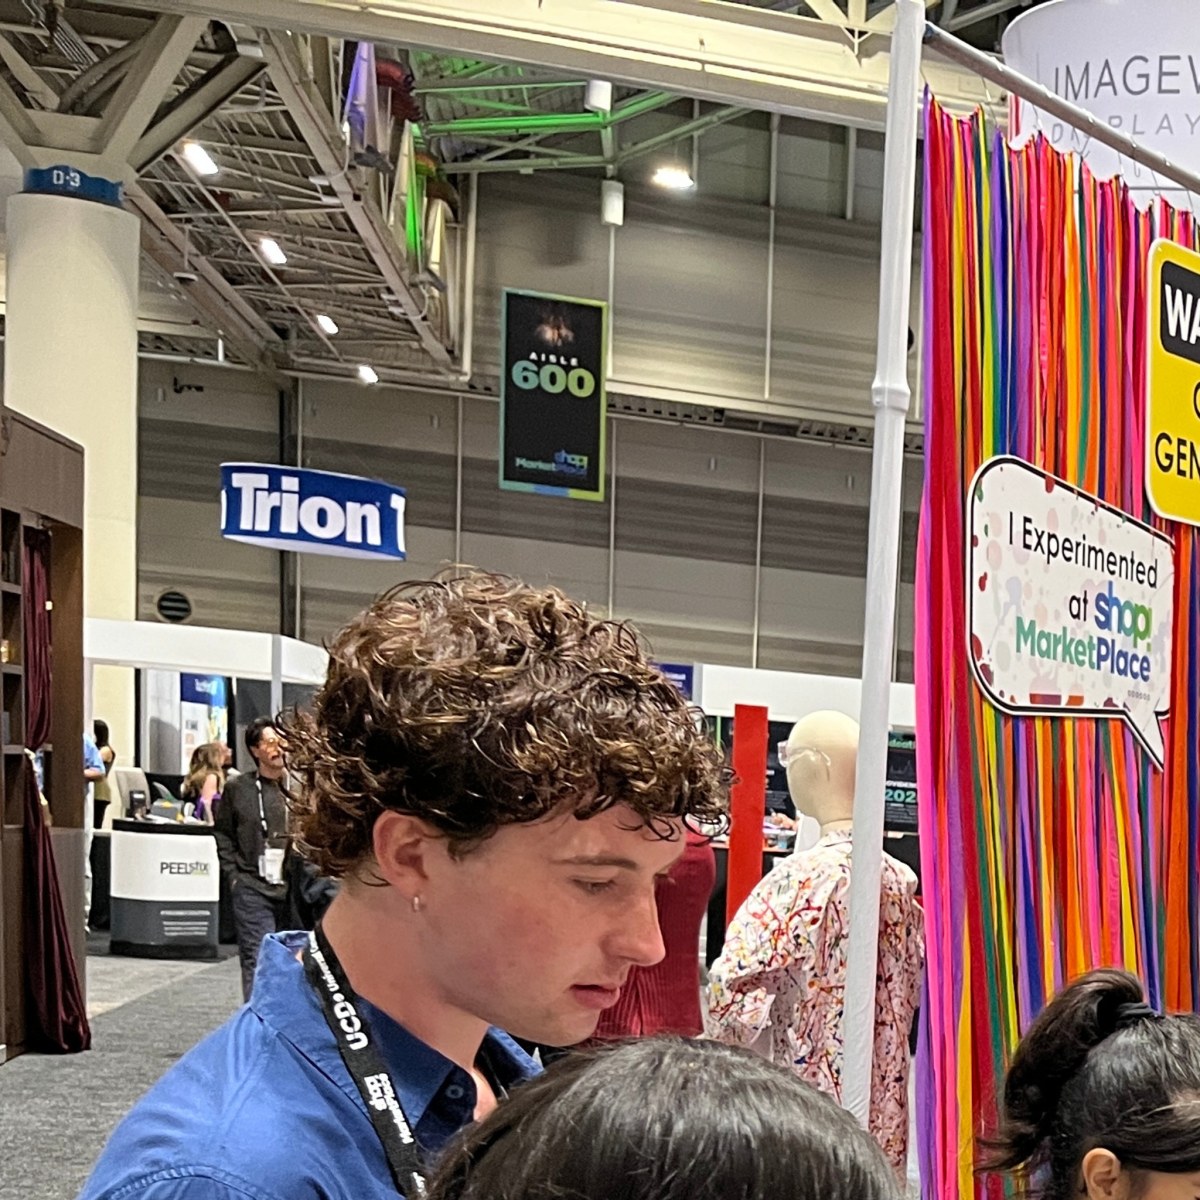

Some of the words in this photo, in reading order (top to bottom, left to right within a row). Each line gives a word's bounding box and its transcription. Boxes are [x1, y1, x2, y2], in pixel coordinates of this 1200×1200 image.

[511, 359, 596, 398] 600
[529, 351, 579, 367] AISLE
[231, 472, 382, 546] Trion
[1022, 515, 1159, 589] Experimented
[1069, 589, 1089, 623] at
[1015, 616, 1152, 683] MarketPlace
[333, 1000, 369, 1051] UCD
